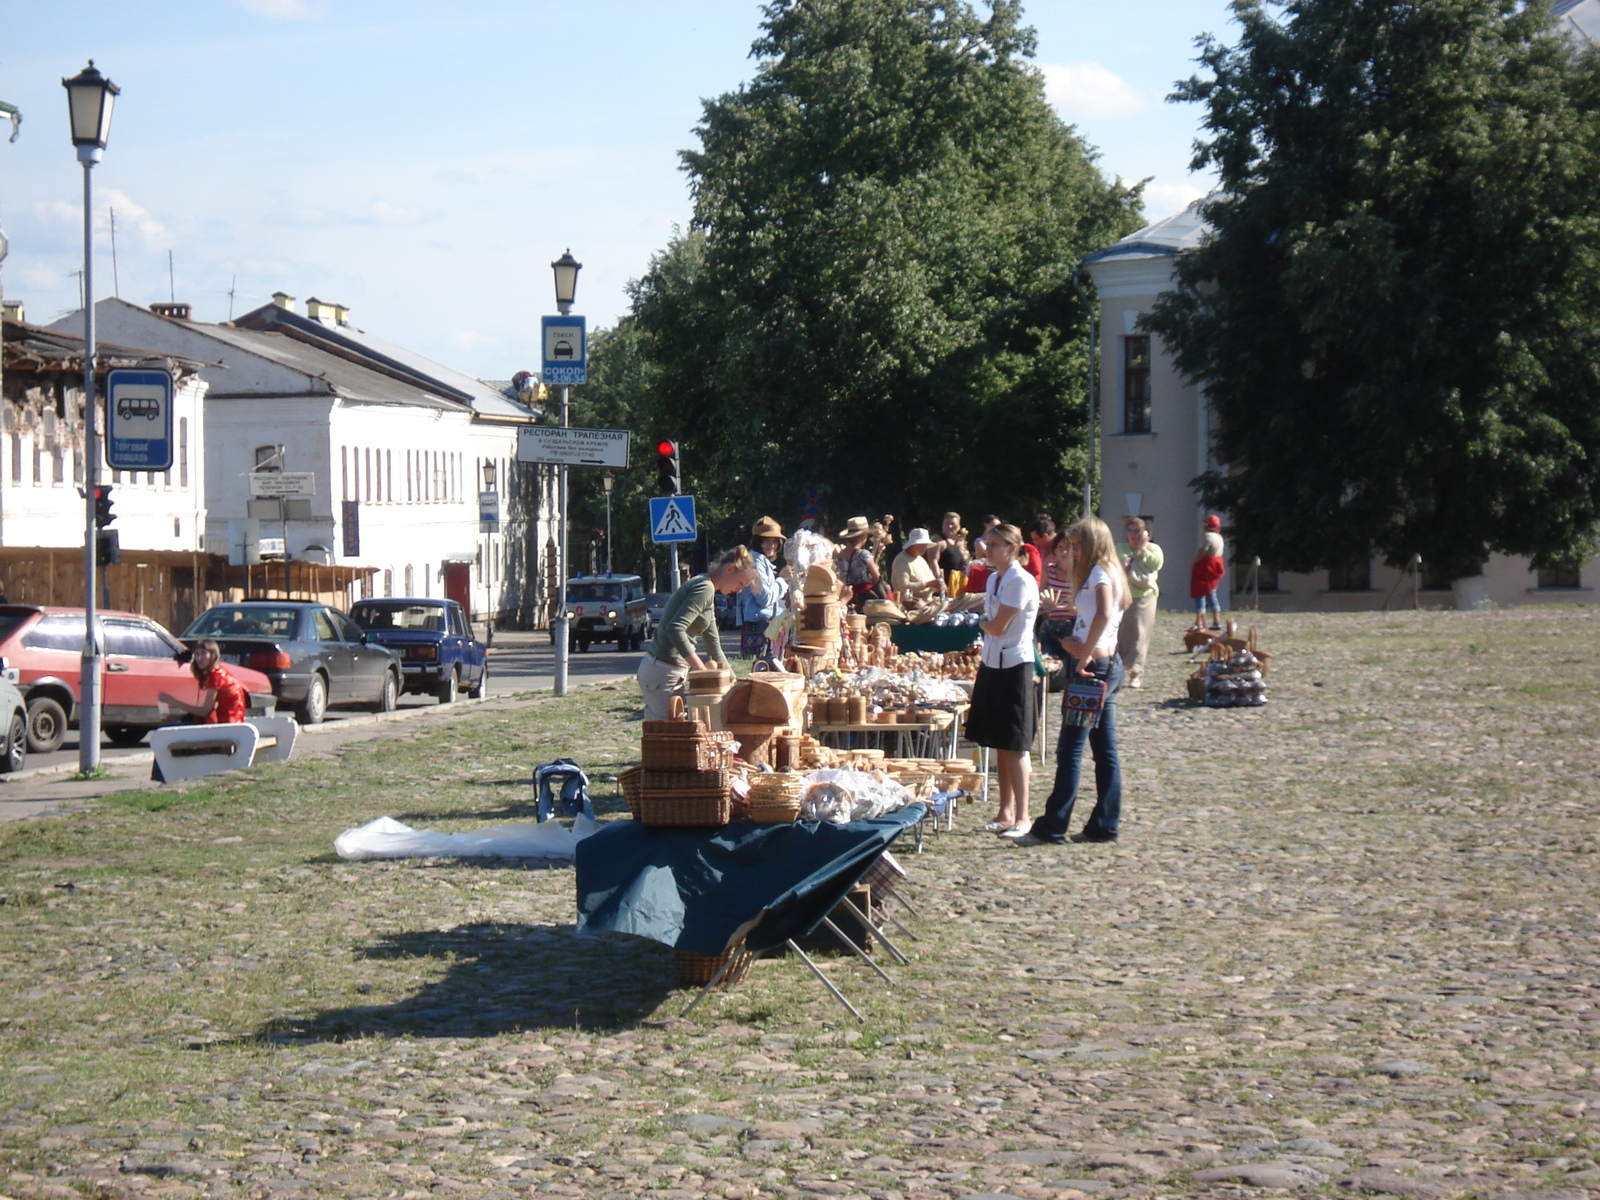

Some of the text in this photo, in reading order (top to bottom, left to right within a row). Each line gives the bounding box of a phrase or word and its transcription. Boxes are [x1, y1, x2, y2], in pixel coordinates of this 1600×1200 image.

[523, 428, 623, 440] РЕСТОРАН ТРАПЕЗНАЯ
[543, 438, 585, 446] СУЗДАЛЬСКОМ
